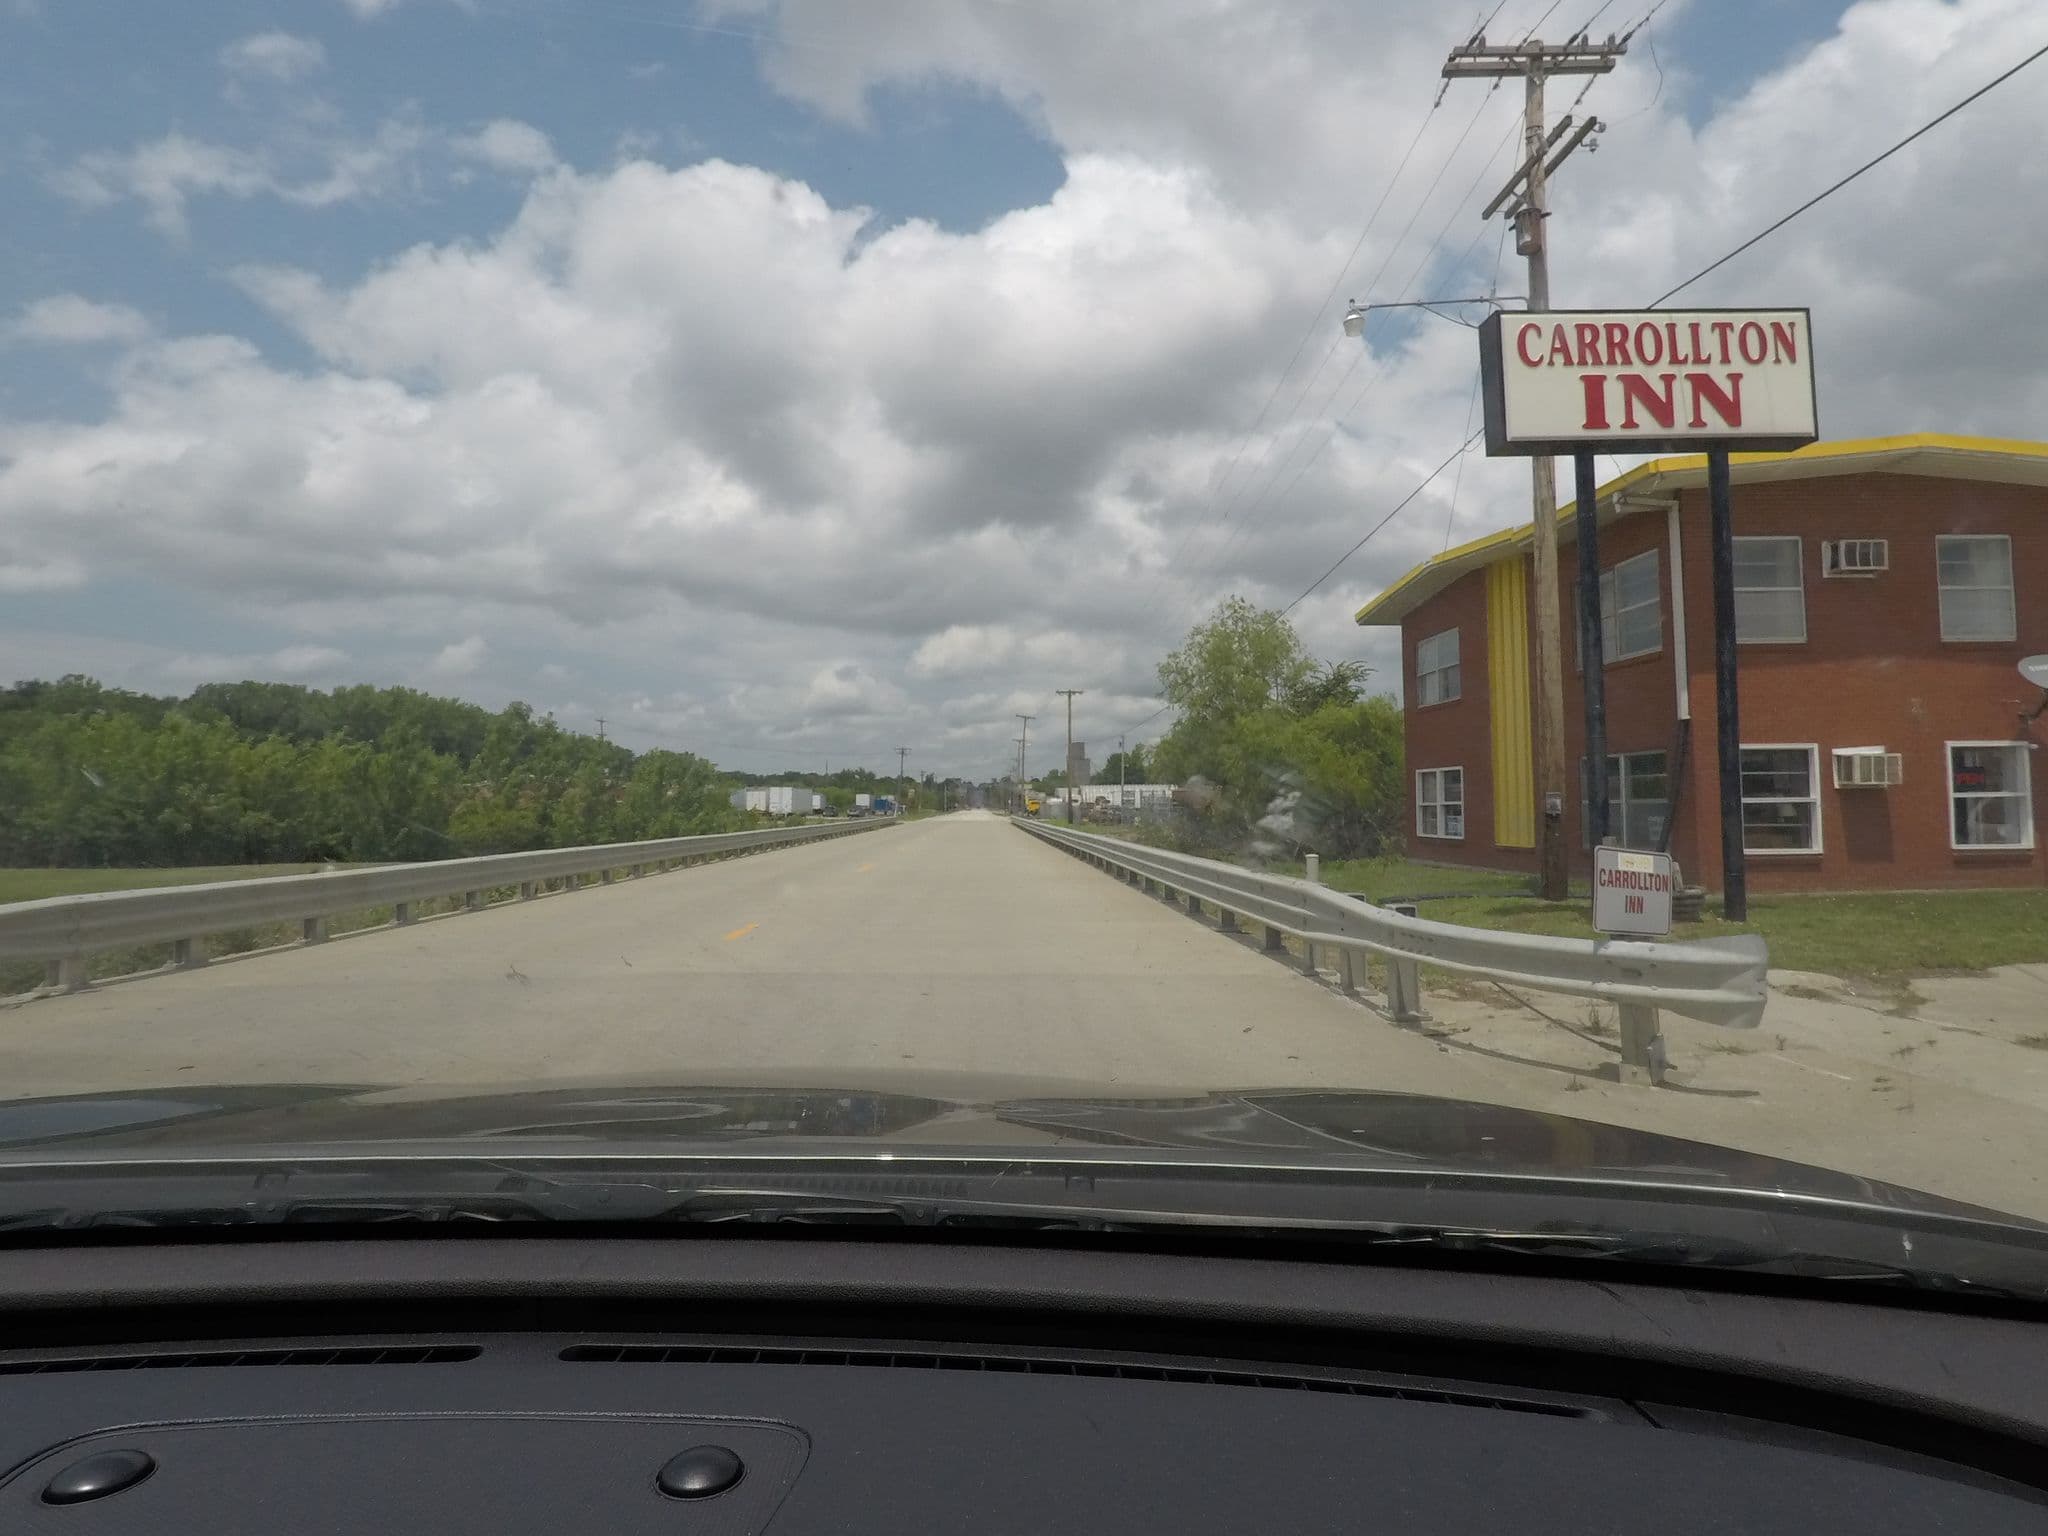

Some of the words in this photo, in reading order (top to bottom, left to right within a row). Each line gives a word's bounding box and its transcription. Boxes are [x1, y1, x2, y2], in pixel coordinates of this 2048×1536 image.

[1516, 320, 1797, 368] CARROLLTON
[1579, 372, 1743, 430] INN
[1599, 868, 1669, 892] CARROLLTON
[1624, 895, 1644, 914] INN
